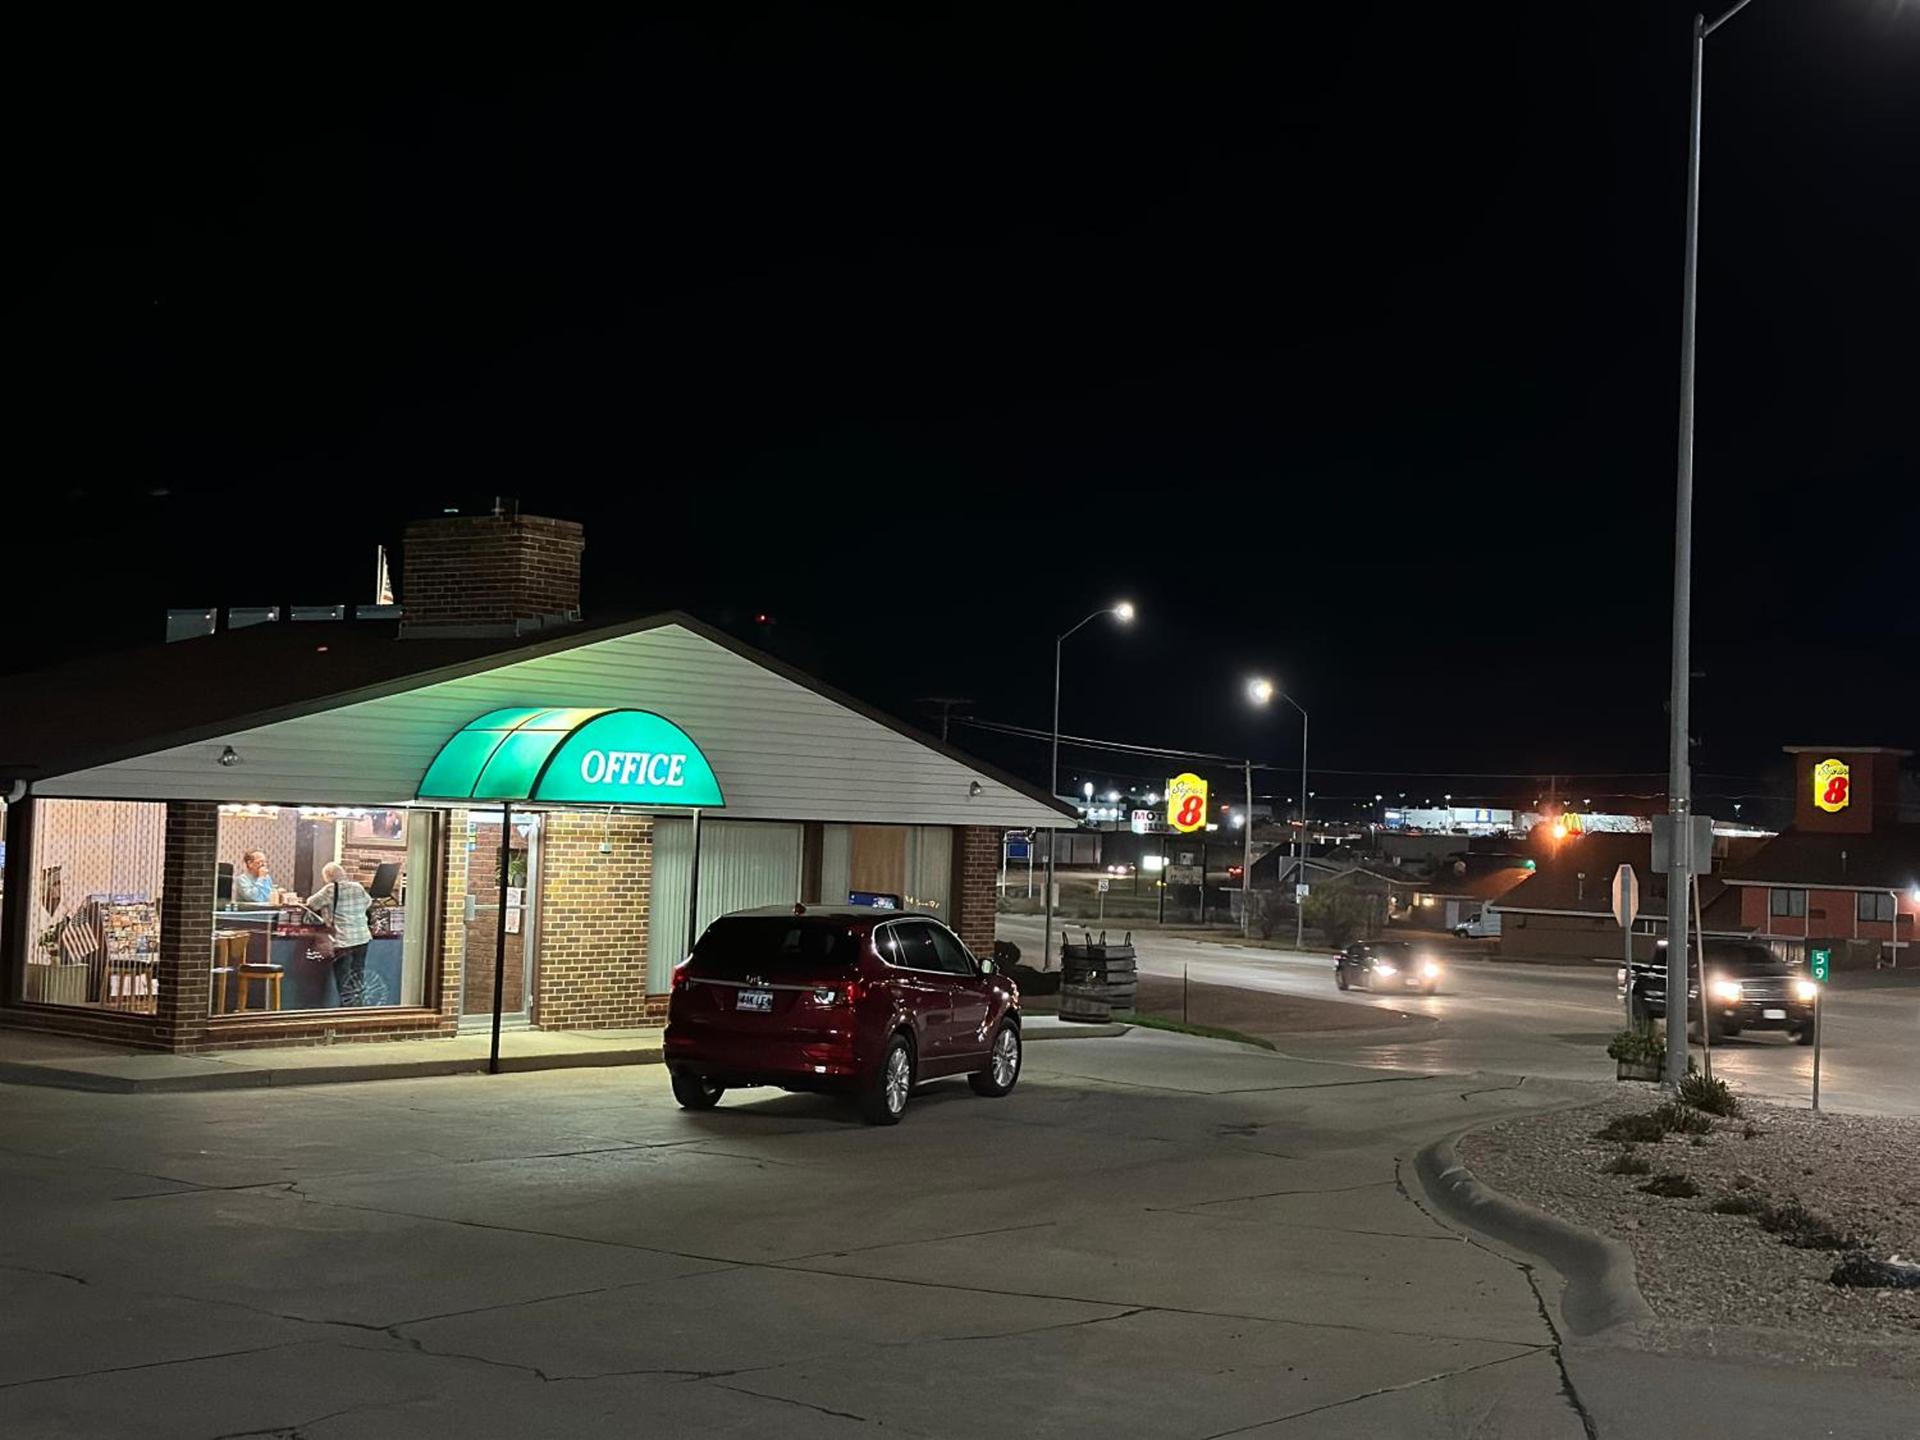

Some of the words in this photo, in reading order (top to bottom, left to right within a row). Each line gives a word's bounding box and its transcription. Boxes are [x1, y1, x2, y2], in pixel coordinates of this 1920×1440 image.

[580, 750, 687, 786] OFFICE
[1824, 777, 1848, 804] 8
[1134, 811, 1162, 821] MOT
[1177, 796, 1203, 826] 8
